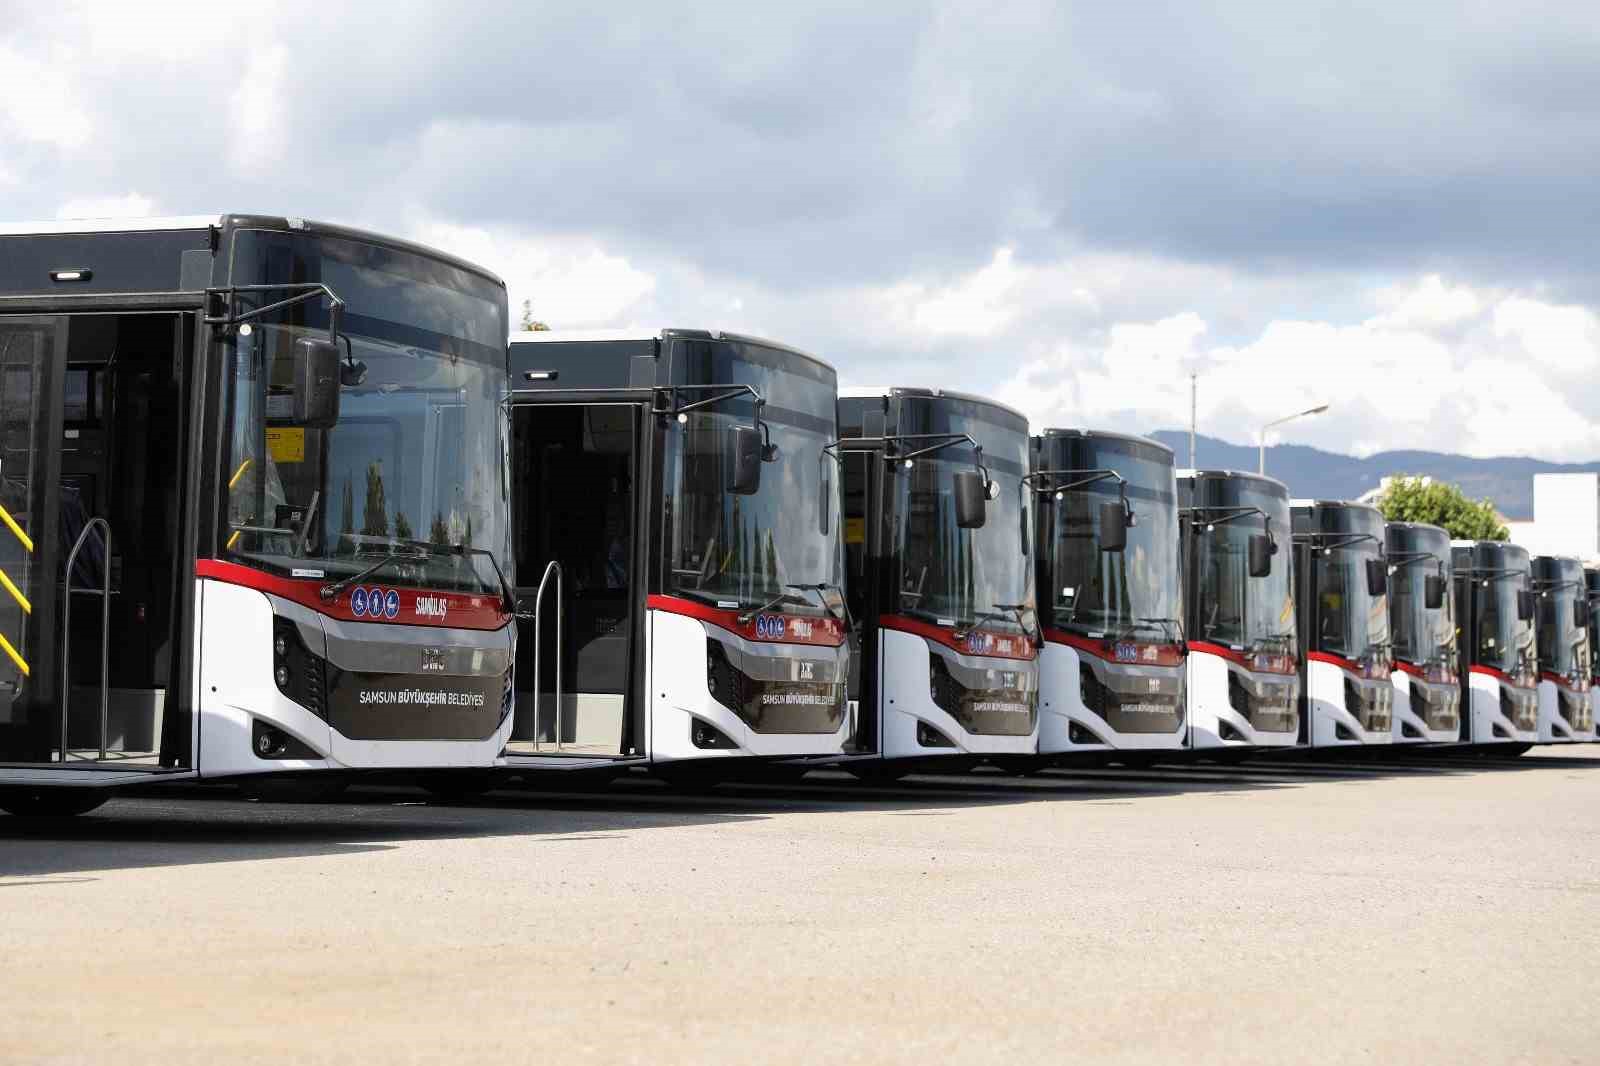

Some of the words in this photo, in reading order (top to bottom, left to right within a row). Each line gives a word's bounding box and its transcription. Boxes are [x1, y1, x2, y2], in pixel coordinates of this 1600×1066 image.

[359, 691, 396, 704] SAMSUN
[397, 689, 446, 707] BÜYÜKŞEHİR
[447, 692, 484, 706] BELEDİYESİ
